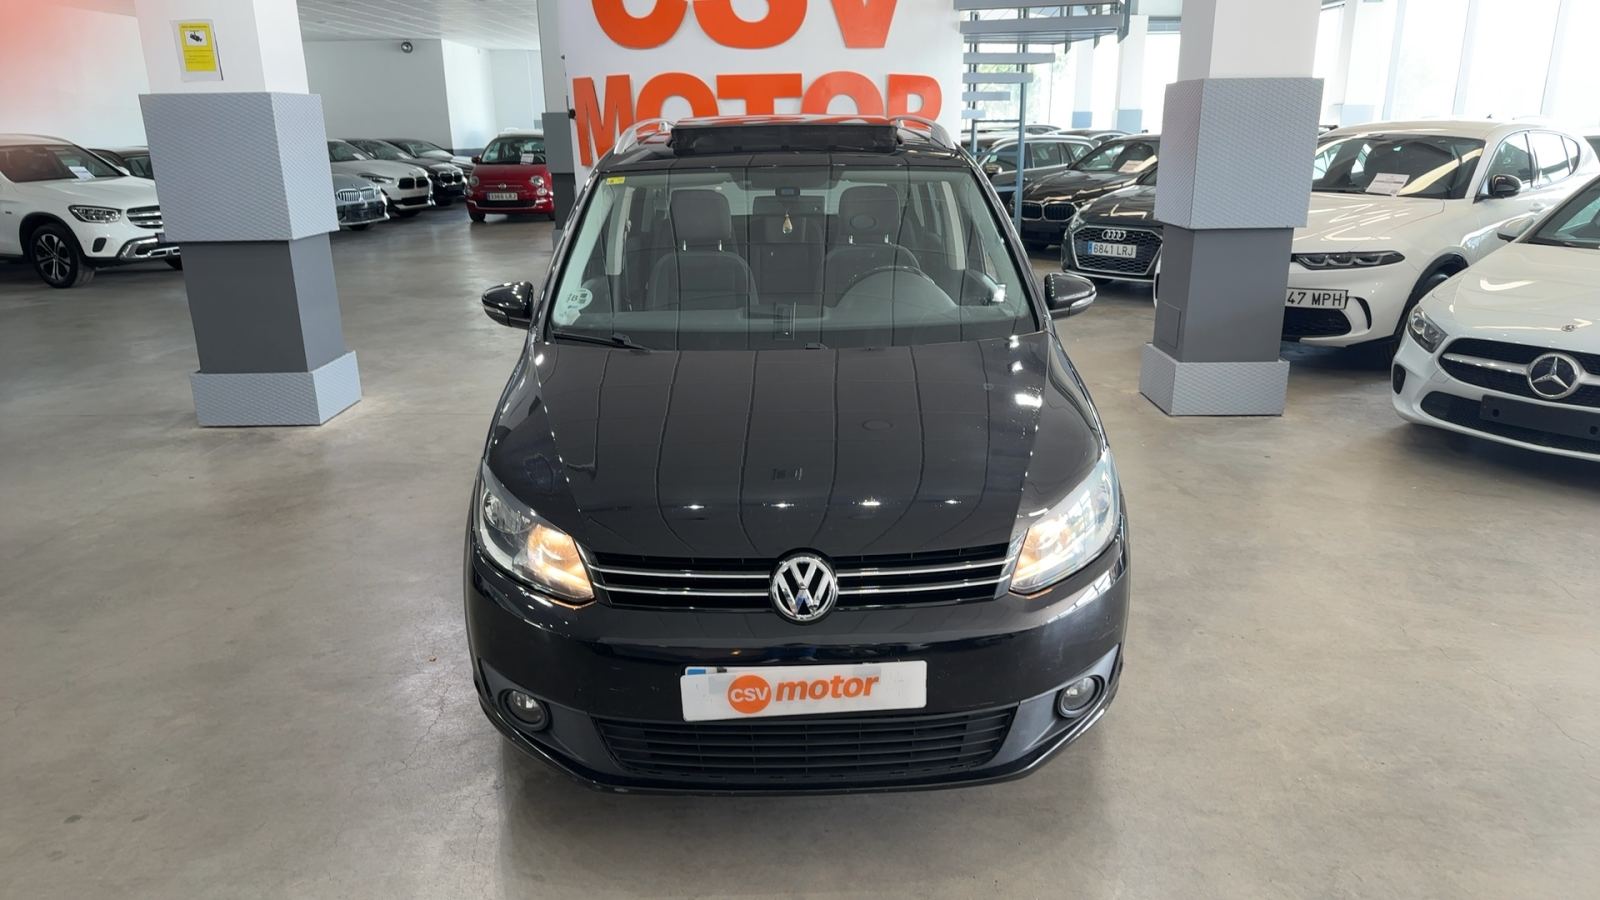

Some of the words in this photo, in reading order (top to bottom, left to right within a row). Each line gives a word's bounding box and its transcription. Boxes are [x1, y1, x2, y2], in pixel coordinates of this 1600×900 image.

[1116, 245, 1134, 257] LRJ
[1311, 292, 1342, 307] MPH
[776, 675, 879, 702] motor
